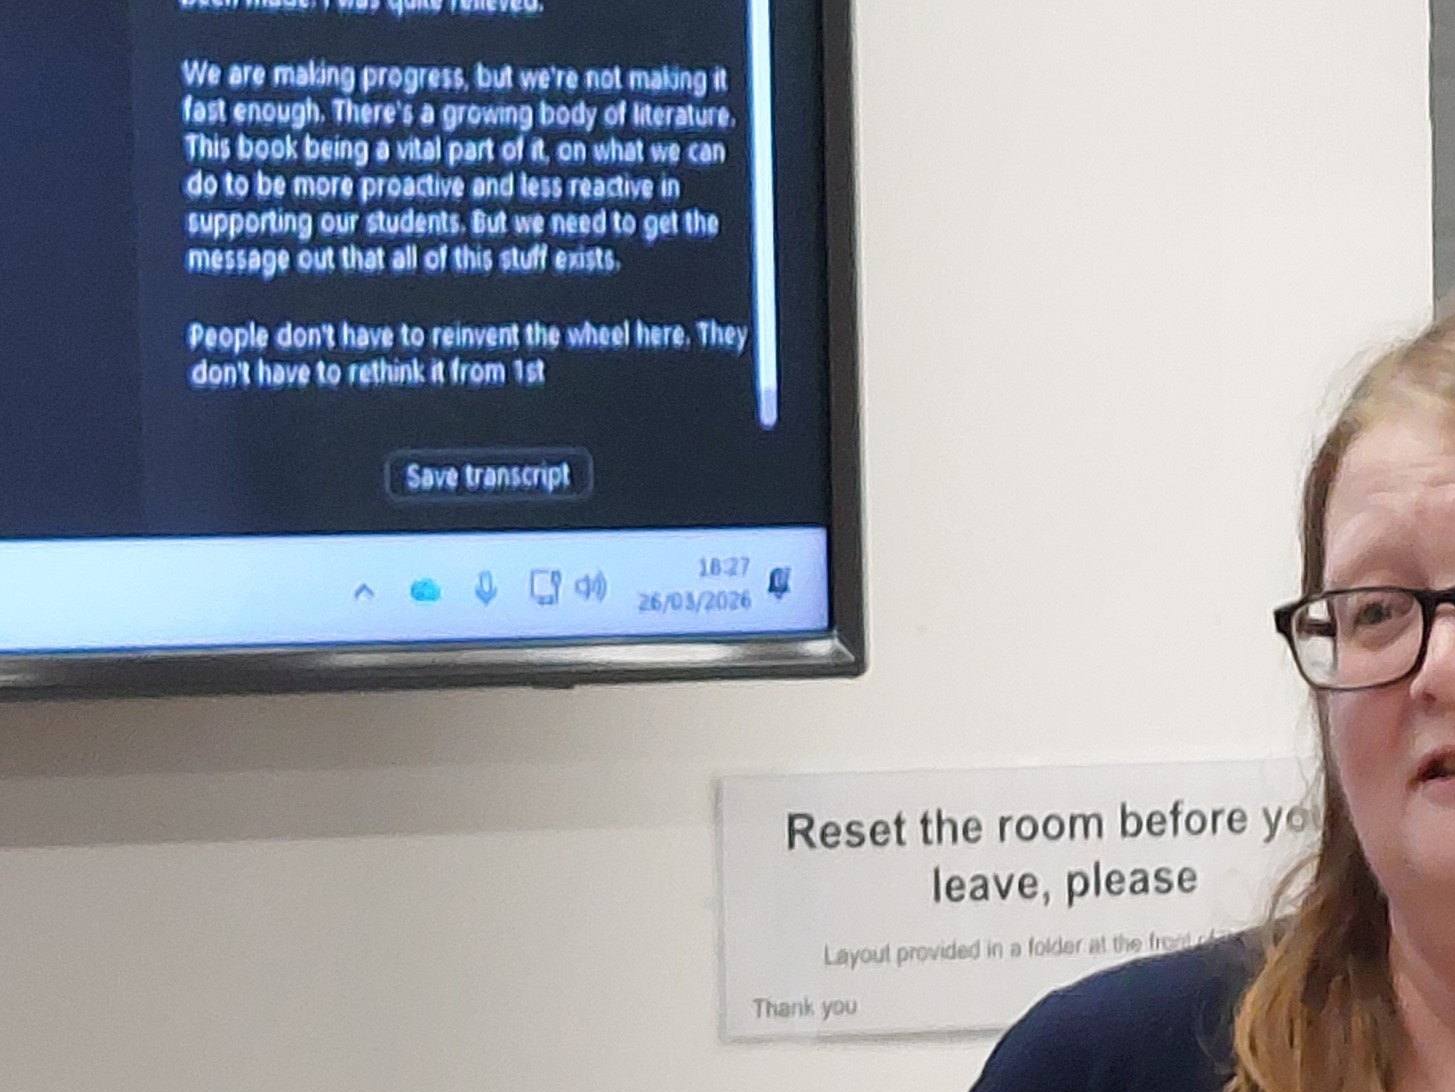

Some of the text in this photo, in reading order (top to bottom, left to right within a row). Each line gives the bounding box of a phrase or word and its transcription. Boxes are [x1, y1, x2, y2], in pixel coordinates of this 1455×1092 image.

[181, 59, 728, 97] We are making progress, but we're not making it
[184, 94, 736, 132] fast enough. There's a growing body of literature.
[185, 133, 230, 161] This
[237, 133, 298, 161] book
[304, 133, 369, 167] being
[375, 140, 390, 161] a
[396, 135, 441, 161] vital
[447, 137, 494, 169] part
[502, 136, 524, 162] of
[557, 141, 587, 163] on
[592, 137, 644, 163] what
[651, 142, 681, 163] we
[687, 142, 726, 164] can
[187, 169, 681, 204] do to be more proactive and less reactive in
[187, 208, 719, 243] supporting our students. But we need to get the
[187, 243, 621, 279] message out that all of this stuff exists.
[189, 318, 748, 357] People don't have to reinvent the wheel here. They
[191, 356, 545, 386] don't have to rethink it from 1st
[406, 461, 570, 493] Save transcript
[638, 590, 751, 614] 26/03/2026
[786, 808, 906, 850] Reset
[919, 807, 983, 846] the
[998, 807, 1103, 843] room
[1120, 799, 1248, 839] before
[932, 860, 1198, 908] leave, please
[823, 941, 891, 971] Layout
[896, 937, 980, 968] provided
[987, 937, 1004, 959] in
[1010, 941, 1022, 958] a
[1028, 935, 1082, 957] folder
[1089, 935, 1106, 954] at
[1113, 932, 1143, 954] the
[752, 995, 858, 1021] Thank you
